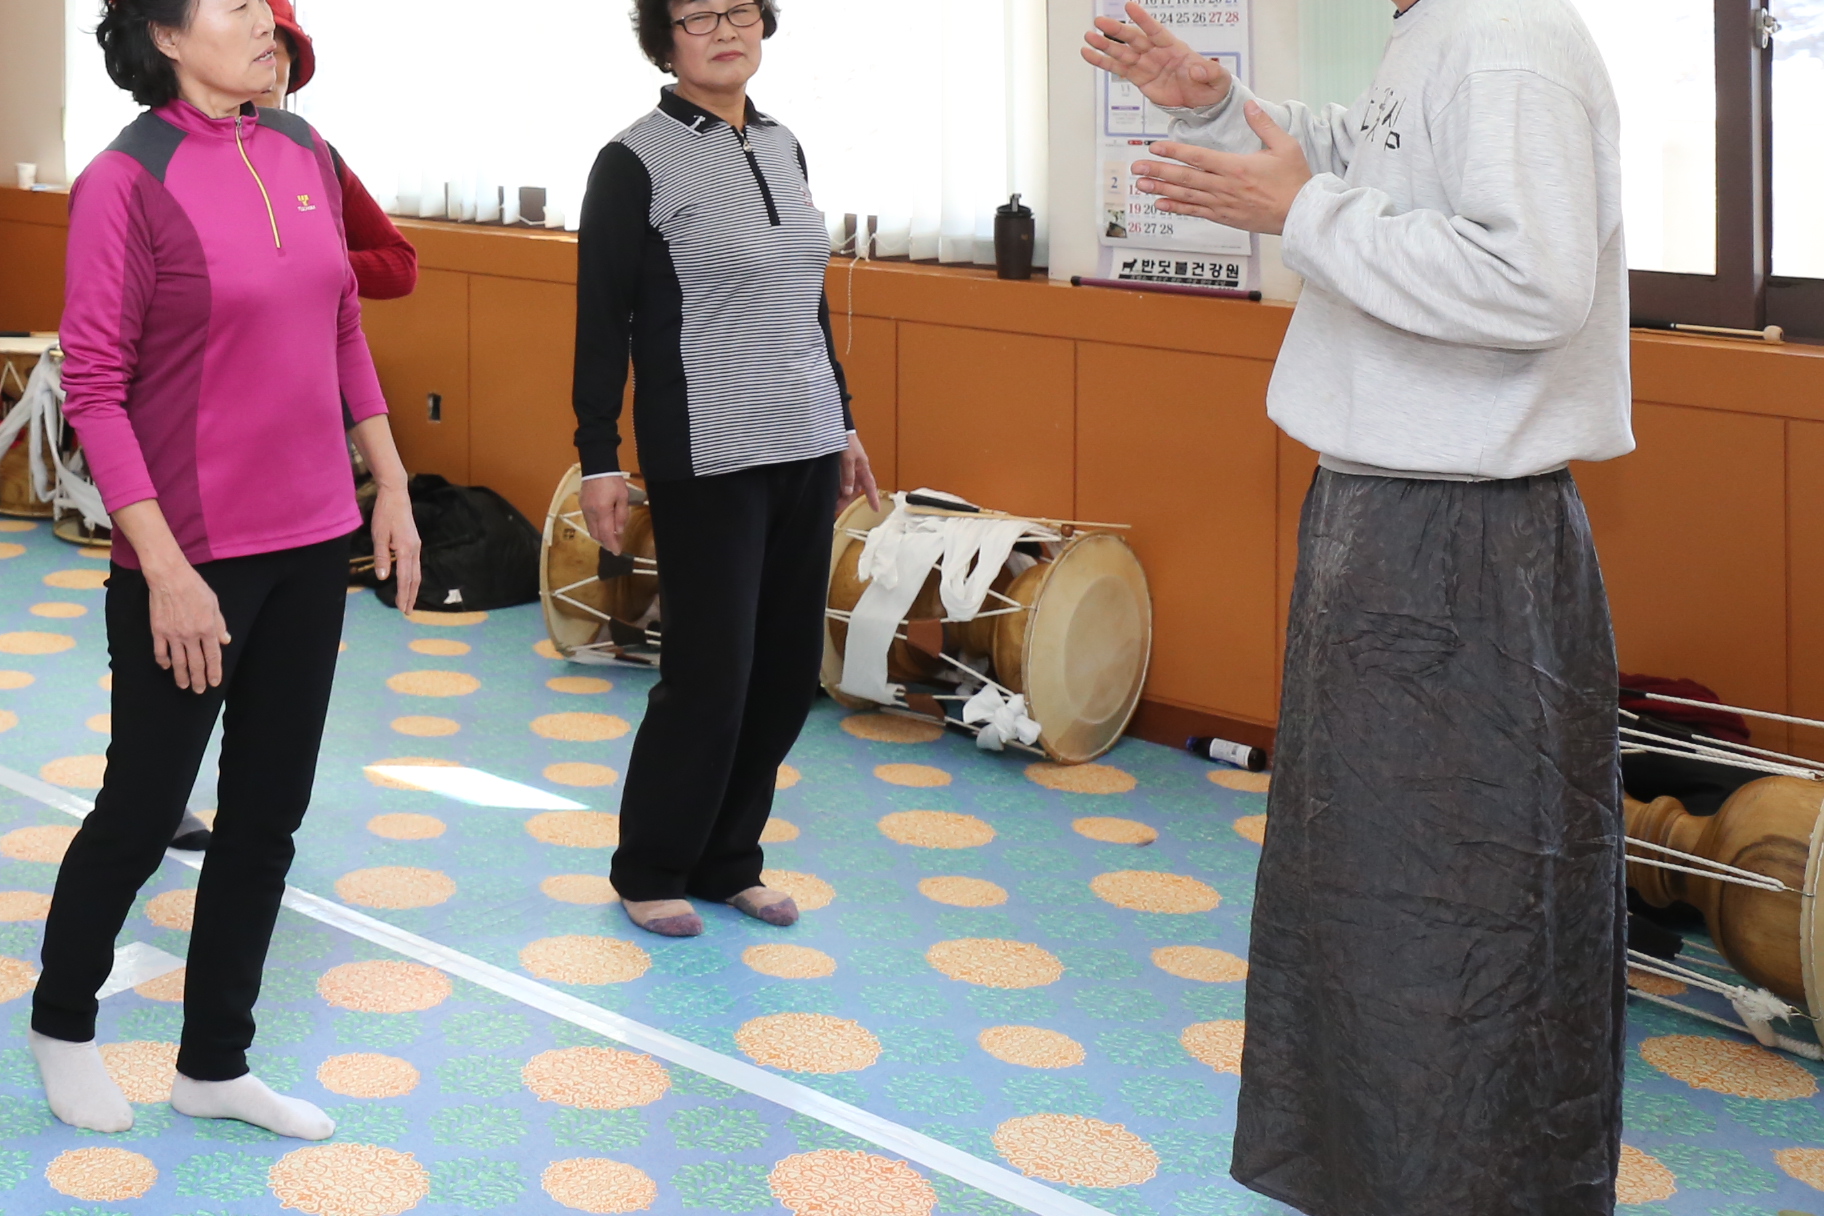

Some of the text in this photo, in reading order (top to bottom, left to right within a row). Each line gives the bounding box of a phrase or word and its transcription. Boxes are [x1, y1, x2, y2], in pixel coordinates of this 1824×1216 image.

[1159, 13, 1173, 23] 24
[1176, 12, 1190, 23] 25
[1192, 12, 1206, 23] 26
[1209, 12, 1222, 23] 27
[1225, 12, 1239, 23] 28
[1128, 204, 1141, 214] 19
[1143, 204, 1157, 215] 20
[1128, 222, 1174, 235] 26 27 28
